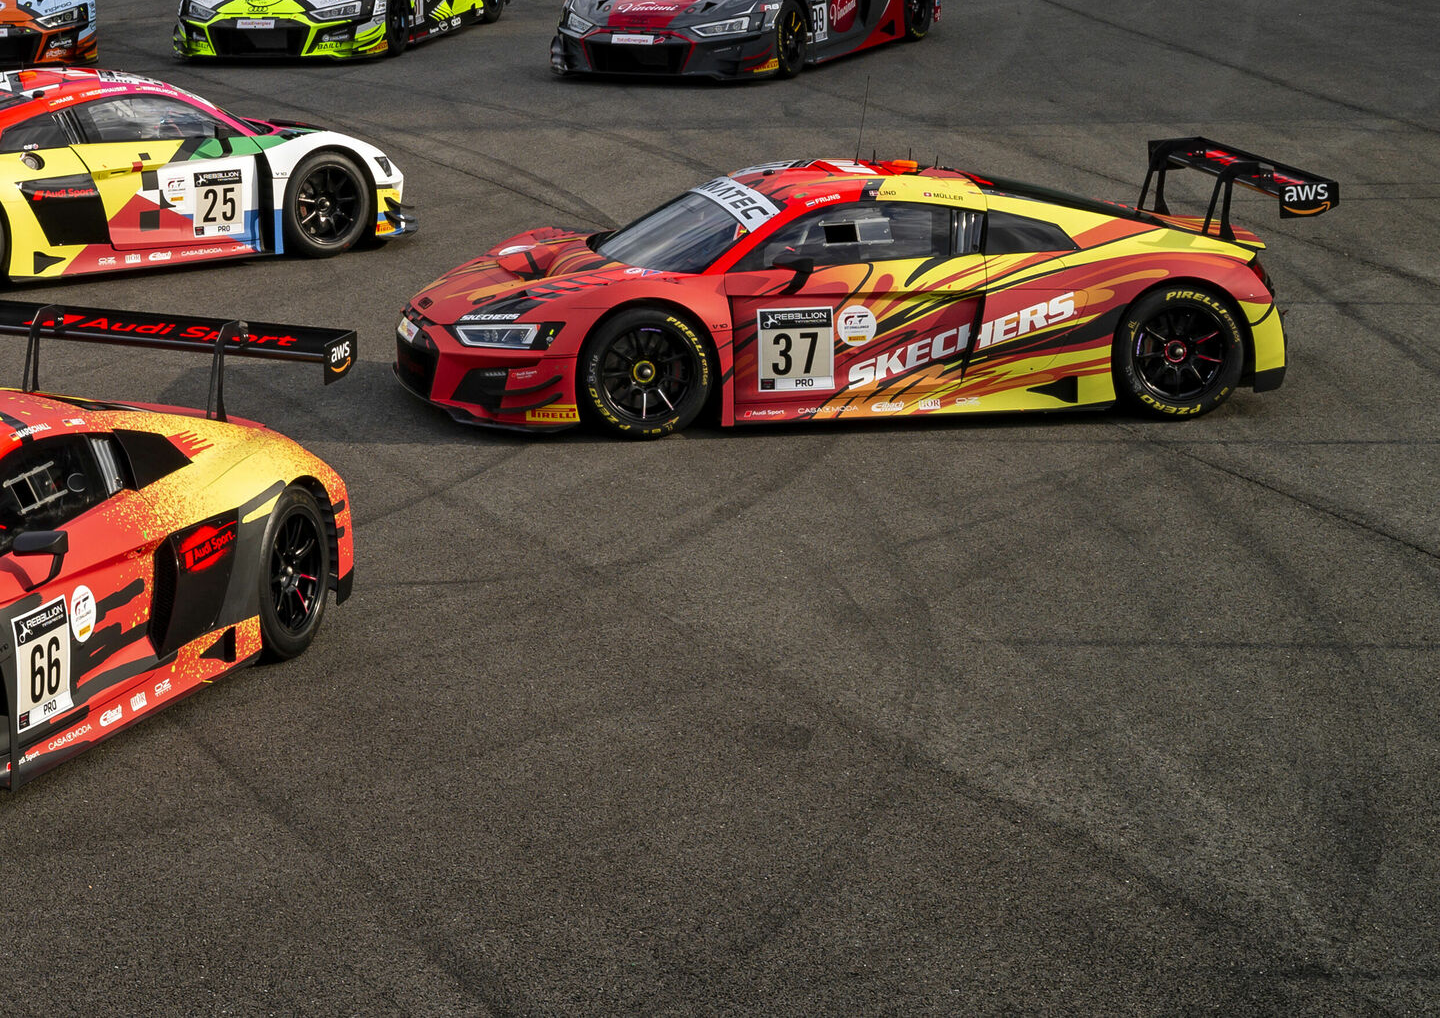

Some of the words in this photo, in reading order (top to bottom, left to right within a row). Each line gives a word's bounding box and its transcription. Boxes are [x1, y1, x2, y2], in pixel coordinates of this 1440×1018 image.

[44, 189, 67, 199] Audi
[67, 186, 96, 199] Sport
[815, 193, 841, 204] FRIJNS
[933, 192, 964, 201] MÜLLER
[1284, 183, 1329, 203] aws
[202, 187, 237, 223] 25
[1166, 290, 1227, 316] PIRELLI
[460, 313, 521, 321] SKECHERS
[78, 317, 178, 336] Audi
[179, 326, 297, 348] Sport
[666, 316, 706, 357] PIRELLI
[848, 291, 1078, 391] SKECHERS
[330, 340, 351, 364] aws
[771, 332, 819, 376] 37
[795, 379, 814, 388] PRO
[530, 408, 577, 419] PIRELLI
[767, 409, 785, 417] Sport
[194, 541, 213, 561] Audi
[210, 530, 234, 550] Sport
[30, 635, 61, 704] 66
[43, 699, 57, 715] PRO
